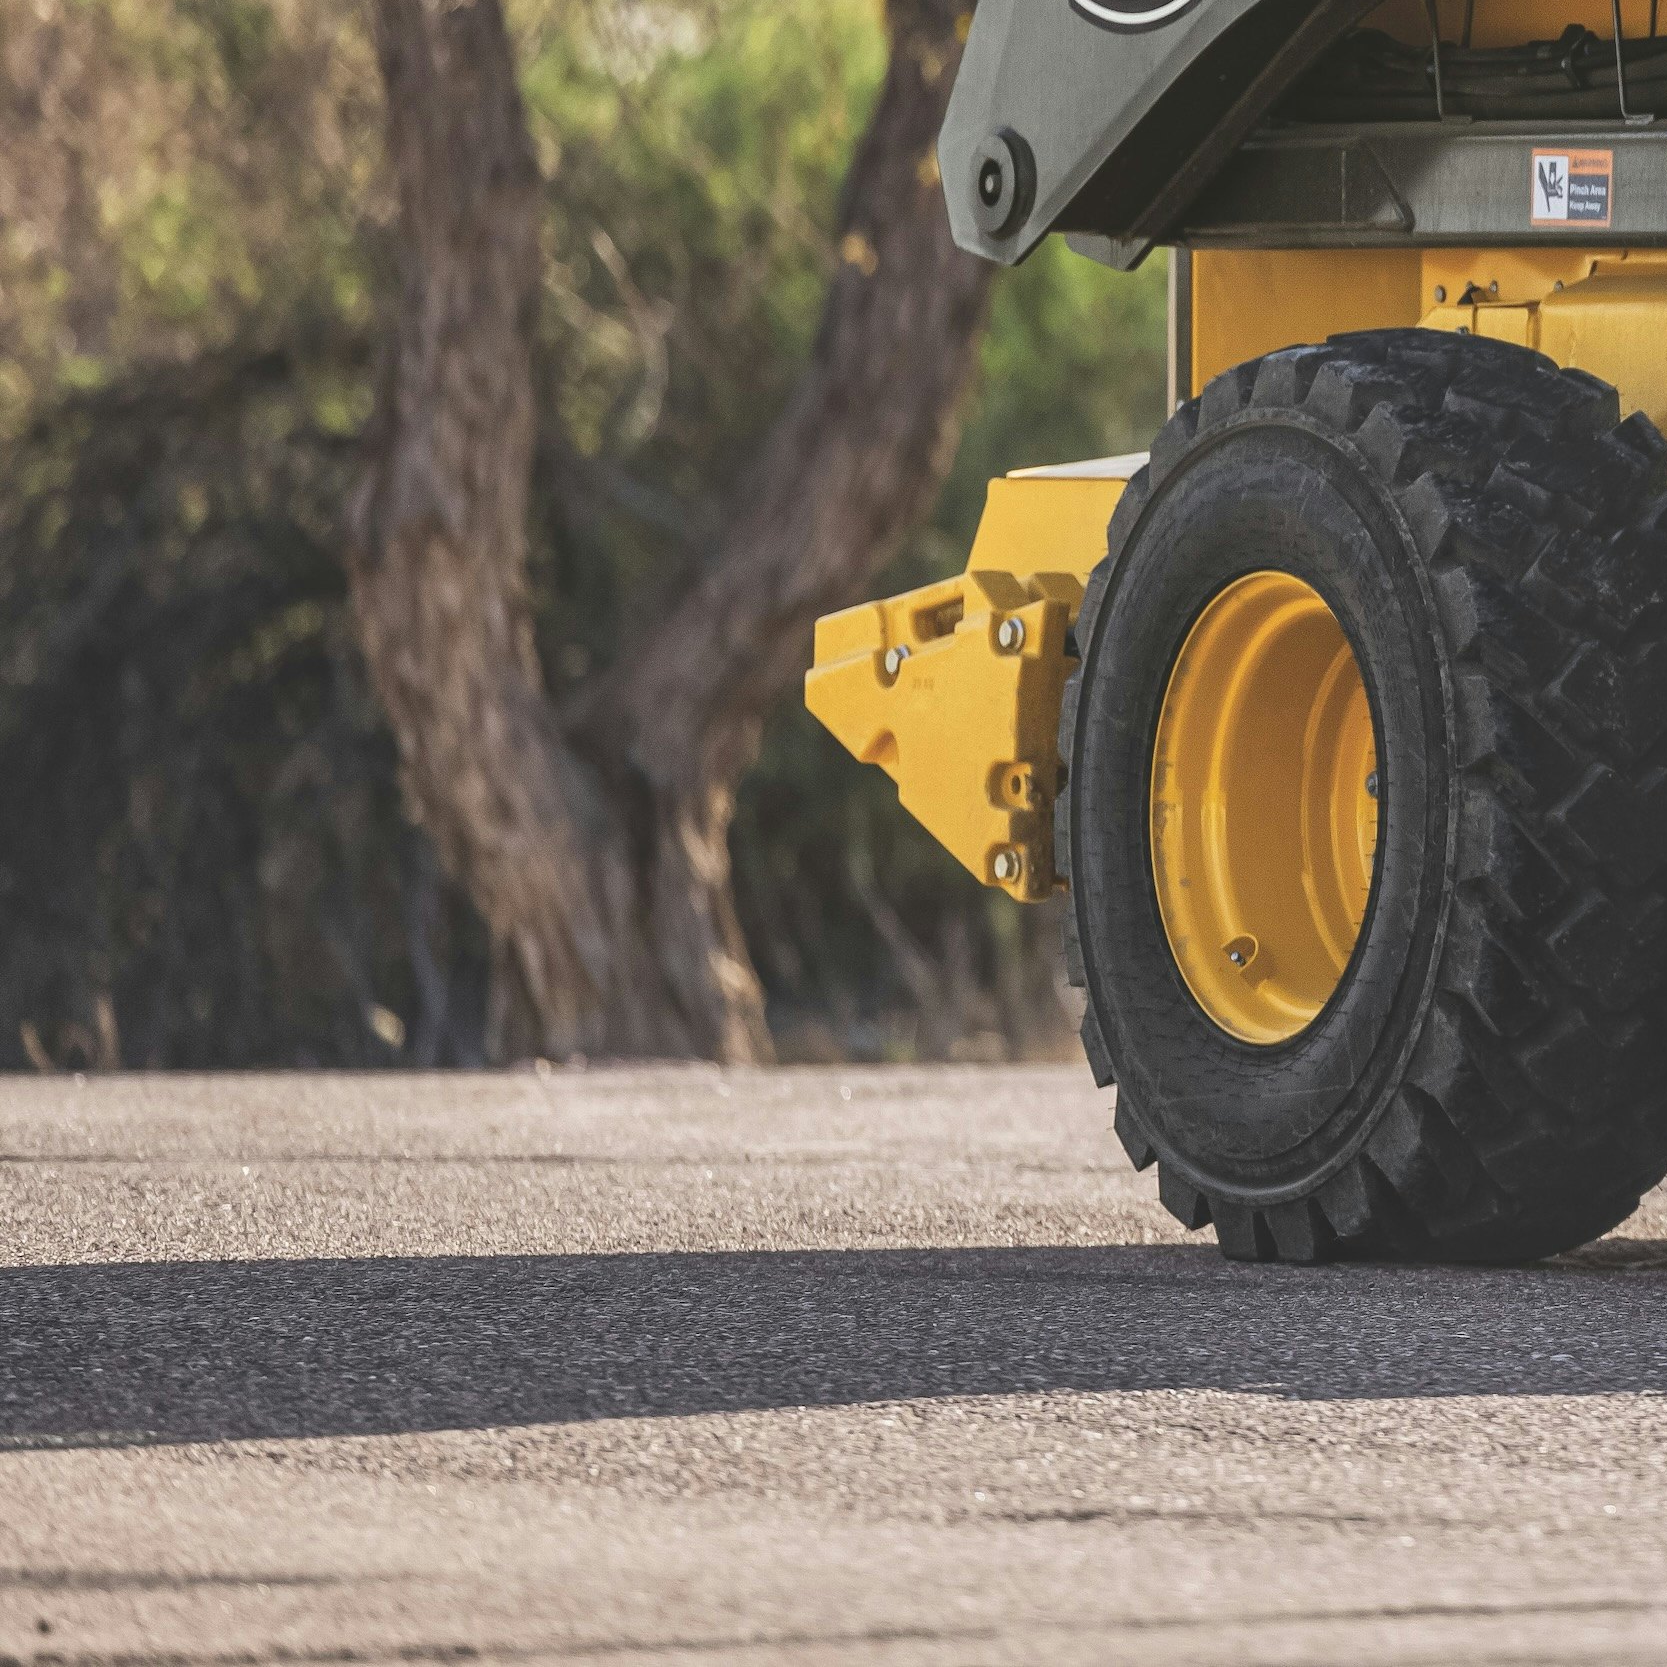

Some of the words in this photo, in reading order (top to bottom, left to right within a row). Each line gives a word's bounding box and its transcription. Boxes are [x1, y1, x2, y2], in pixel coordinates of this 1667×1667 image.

[1570, 183, 1589, 196] Pinch
[1590, 184, 1606, 196] Area
[1569, 200, 1584, 213] Keep
[1585, 200, 1601, 212] Away
